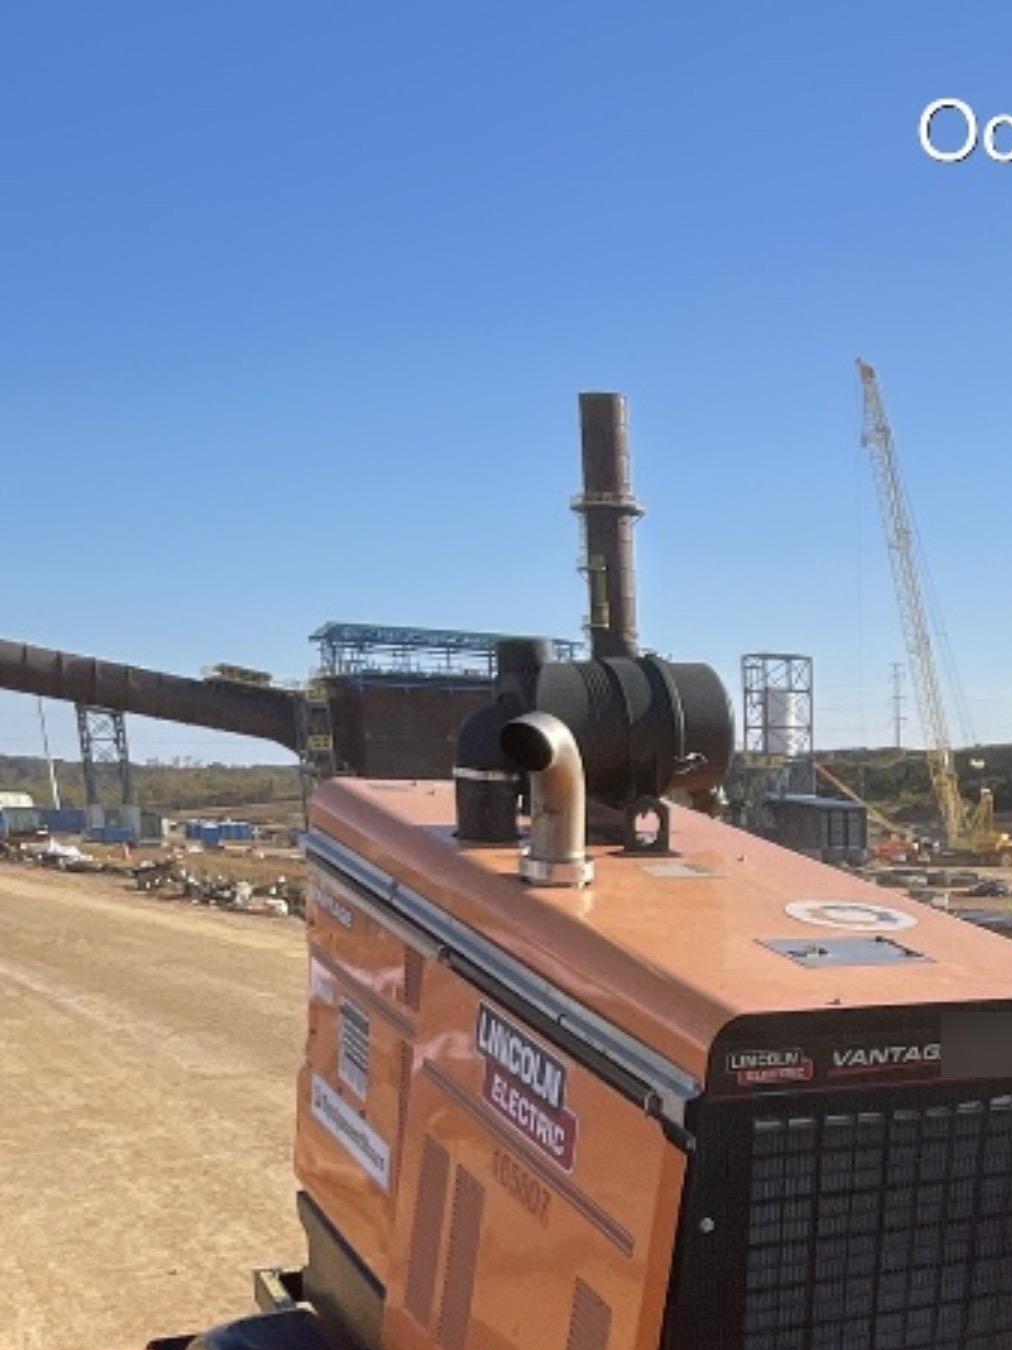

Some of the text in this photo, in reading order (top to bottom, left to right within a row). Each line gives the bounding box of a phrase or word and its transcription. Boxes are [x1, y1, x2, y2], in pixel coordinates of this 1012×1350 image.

[478, 1009, 563, 1109] LINCOLN
[730, 1050, 800, 1070] LINCOLN
[832, 1043, 941, 1067] VANTAG
[490, 1072, 566, 1157] ELECTRIC
